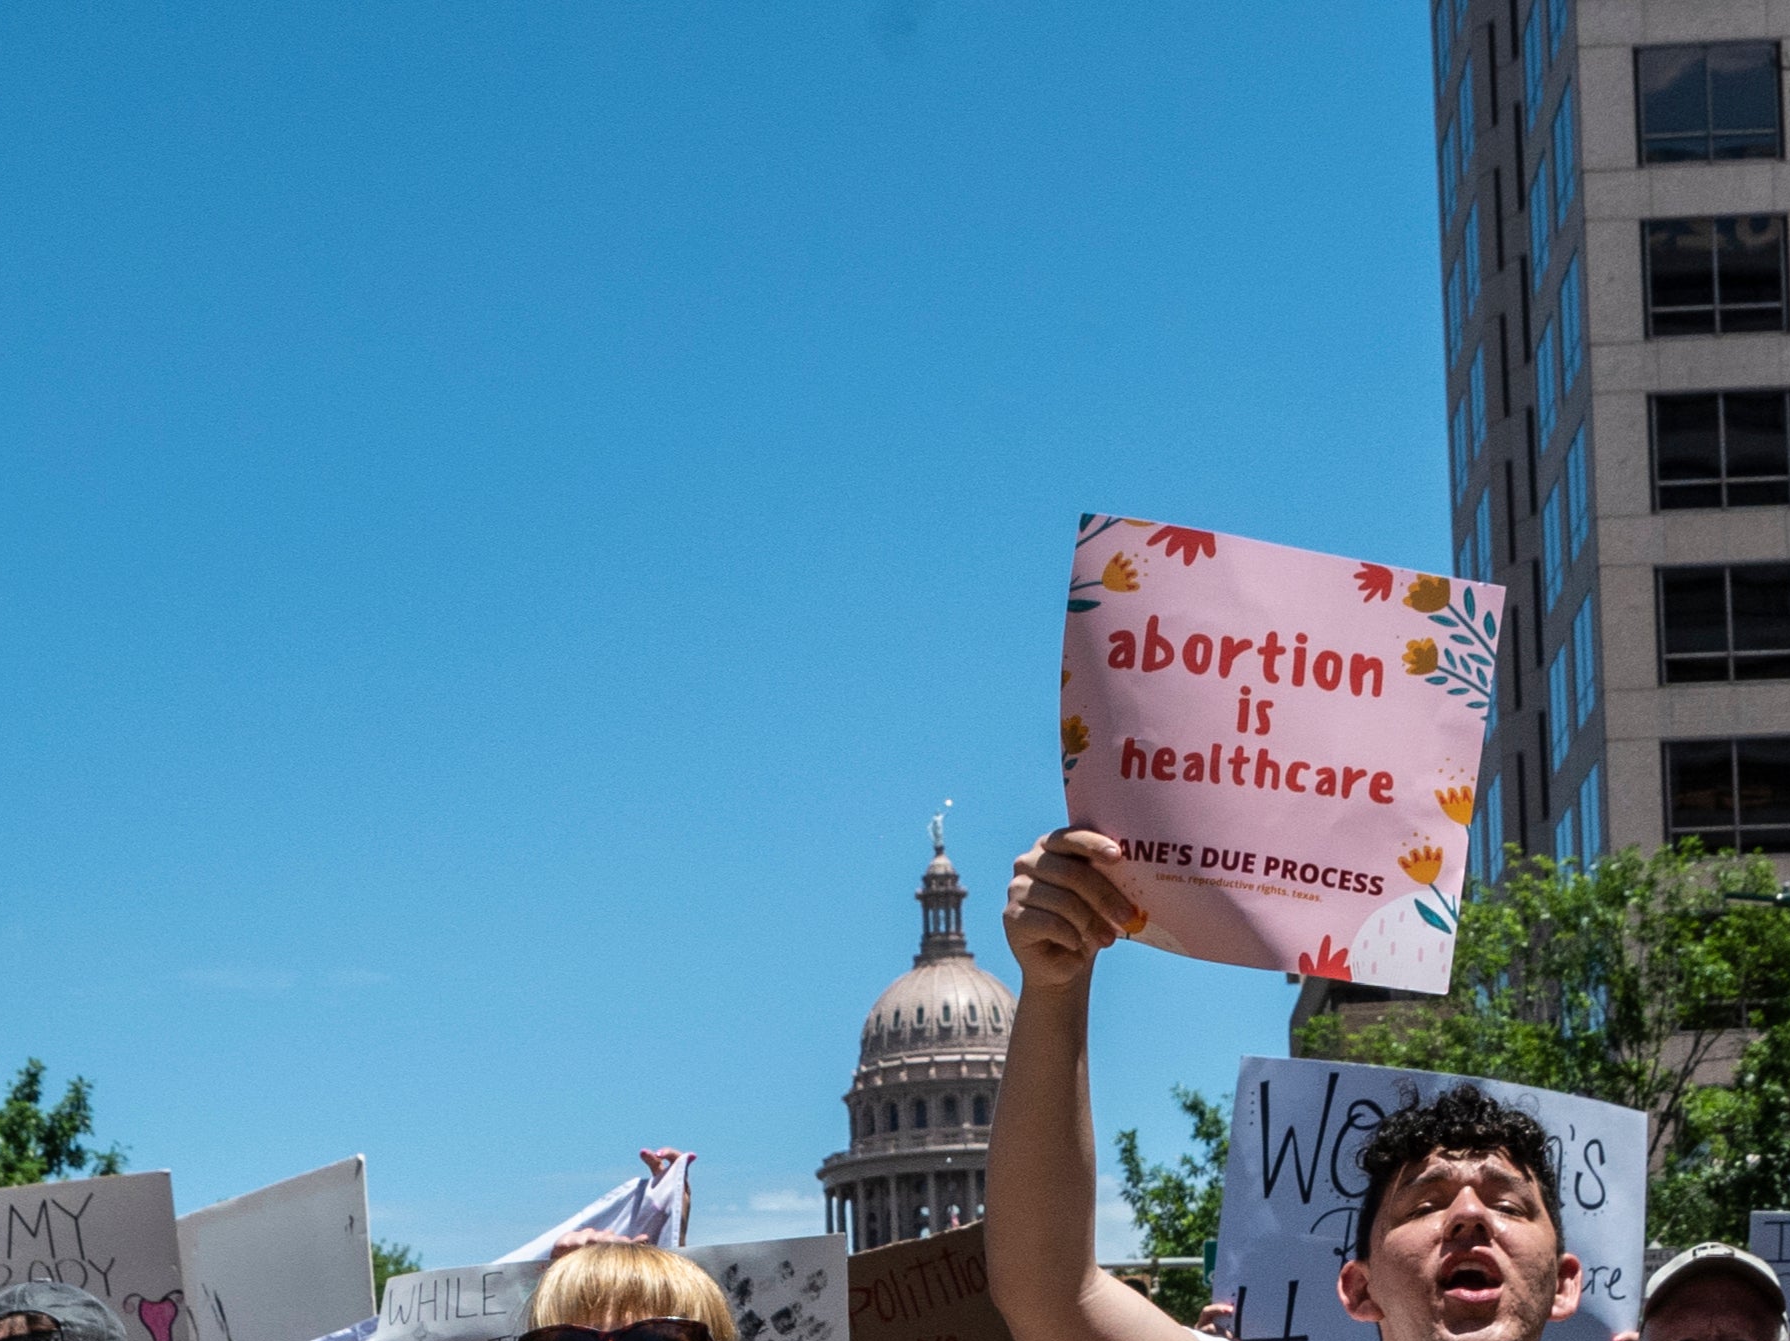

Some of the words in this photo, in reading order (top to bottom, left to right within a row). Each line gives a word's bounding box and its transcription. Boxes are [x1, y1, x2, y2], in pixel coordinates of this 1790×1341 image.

[1107, 614, 1384, 698] abortion
[1236, 685, 1275, 736] is
[1120, 738, 1395, 805] healthcare
[1117, 837, 1194, 867] ANE'S
[1200, 847, 1257, 875] DUE
[1263, 855, 1386, 897] PROCESS
[1187, 874, 1255, 893] reproductive
[7, 1192, 94, 1261] MY
[387, 1270, 508, 1326] WHILE
